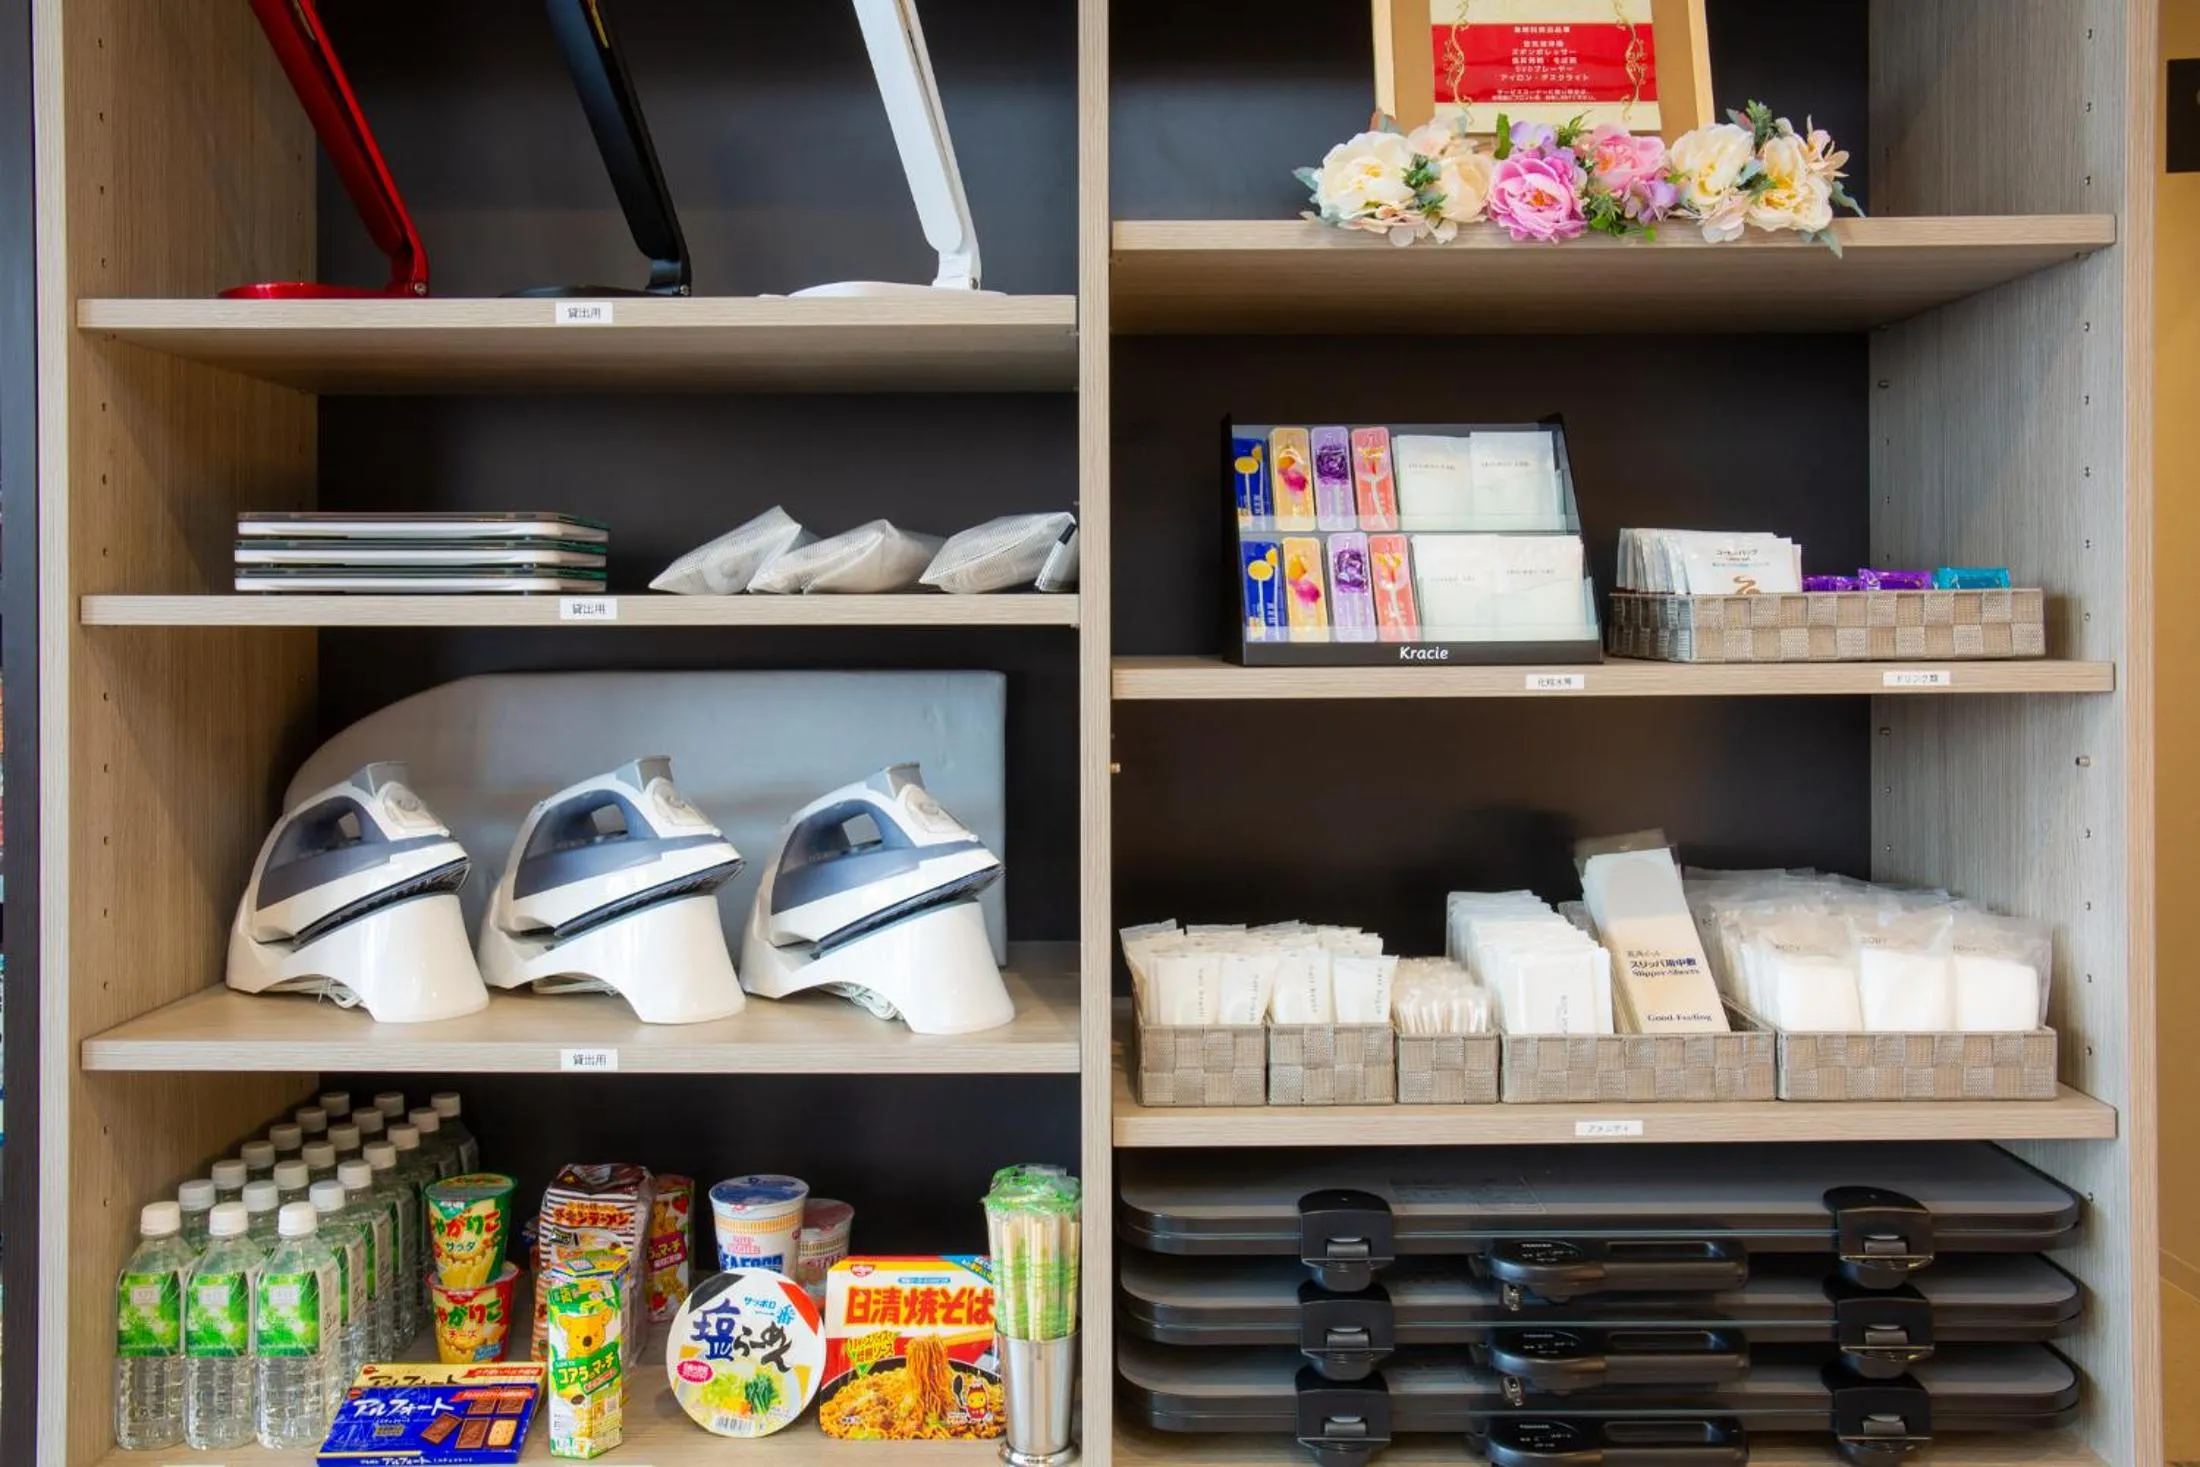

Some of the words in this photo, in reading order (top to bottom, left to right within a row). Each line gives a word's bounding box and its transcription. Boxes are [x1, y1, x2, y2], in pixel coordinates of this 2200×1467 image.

[567, 307, 601, 319] 貸出用
[572, 603, 605, 615] 貸出用
[1400, 646, 1449, 660] Kracie
[572, 1054, 607, 1067] 貸出用
[845, 1285, 995, 1326] 日清焼そば
[557, 1351, 615, 1385] コアラのマーチ
[352, 1396, 455, 1418] アルフォート
